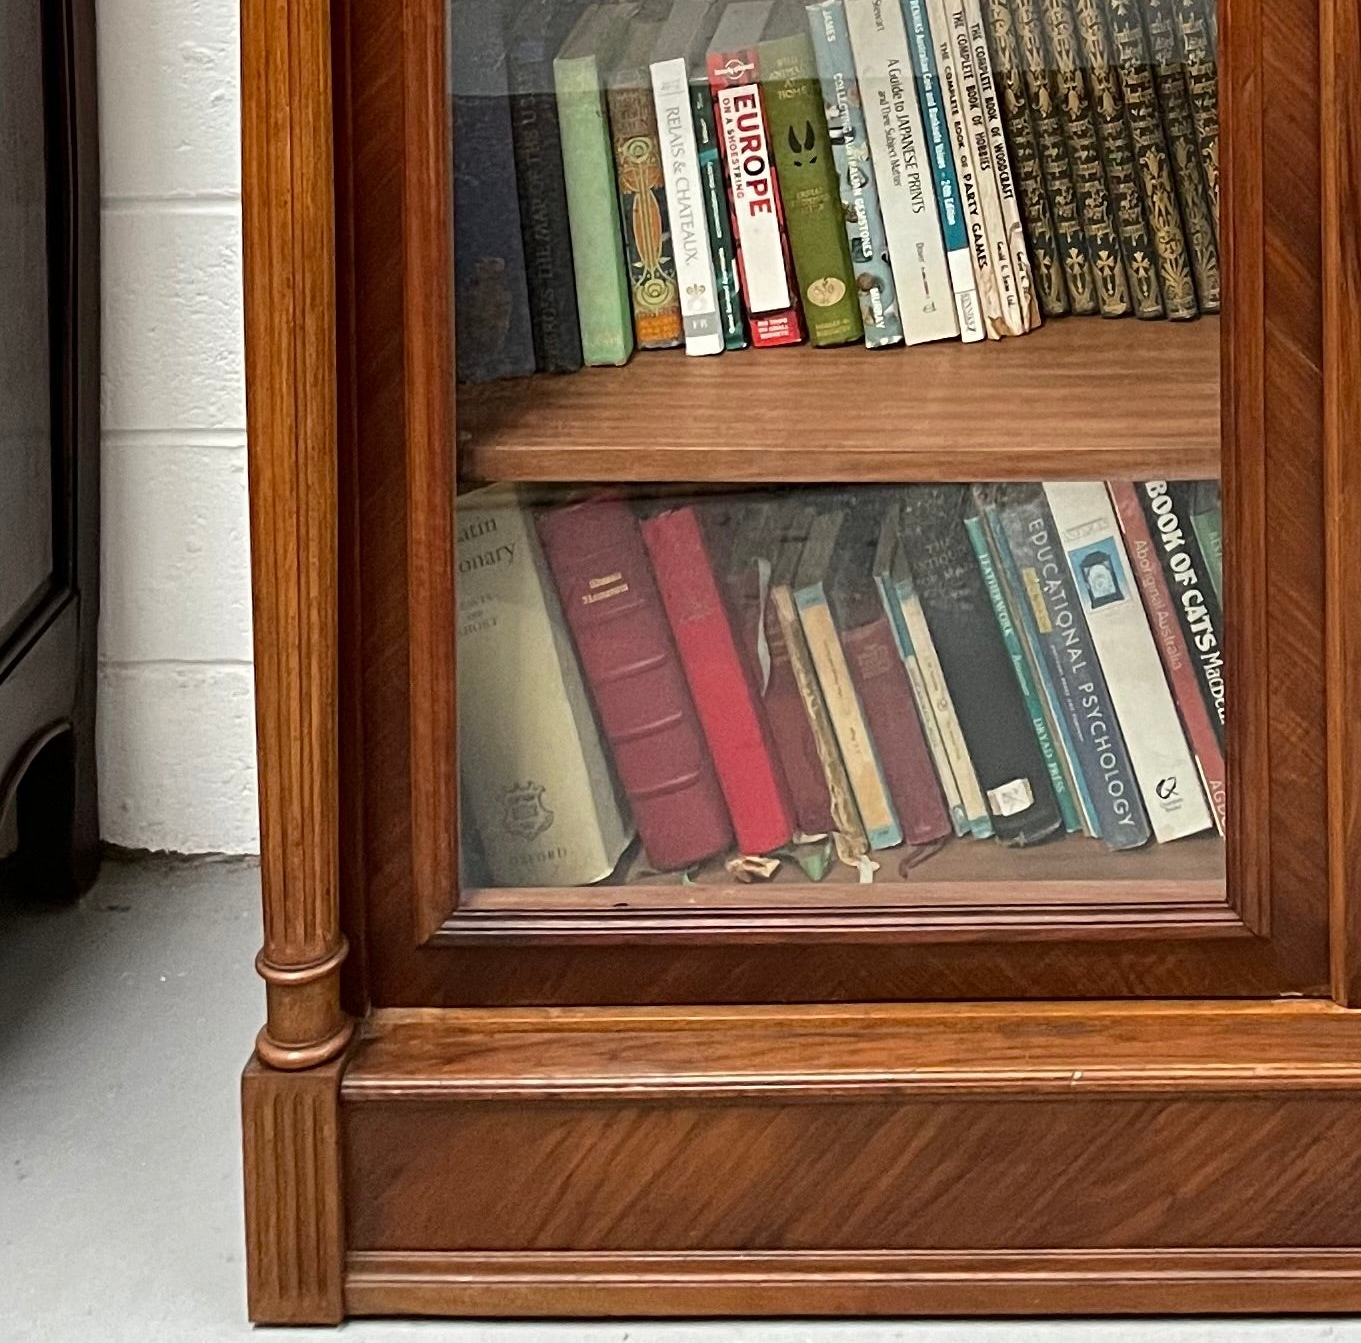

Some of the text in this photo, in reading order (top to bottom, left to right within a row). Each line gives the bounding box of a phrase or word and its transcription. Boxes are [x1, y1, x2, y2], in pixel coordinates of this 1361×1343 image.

[664, 105, 686, 164] RELAIS
[721, 97, 746, 199] ON A SHOESTRING
[733, 92, 773, 218] EUROPE
[877, 89, 888, 106] and
[887, 58, 926, 214] A Guide to JAPANESE PRINTS
[938, 41, 990, 272] THE COMPLETE BOOK OF PARTY GAMES
[951, 10, 992, 172] THE COMPLETE BOOK OF HOBBIES
[969, 22, 1015, 201] THE COMPLETE BOOK OF WOODCRAFT
[672, 161, 685, 175] &
[822, 9, 886, 330] JAMES COLLECTING AUSTRALIAN GEMSTONES MURRAY
[457, 517, 497, 544] atin
[458, 541, 516, 574] onary
[1144, 480, 1219, 656] BOOK OF CATS
[977, 552, 1013, 638] LEATHERWORK
[1031, 717, 1053, 766] DRYAD
[1028, 516, 1088, 675] EDUCATIONAL
[1078, 681, 1136, 828] PSYCHOLOGY
[1133, 538, 1184, 671] Aboriginal Australia
